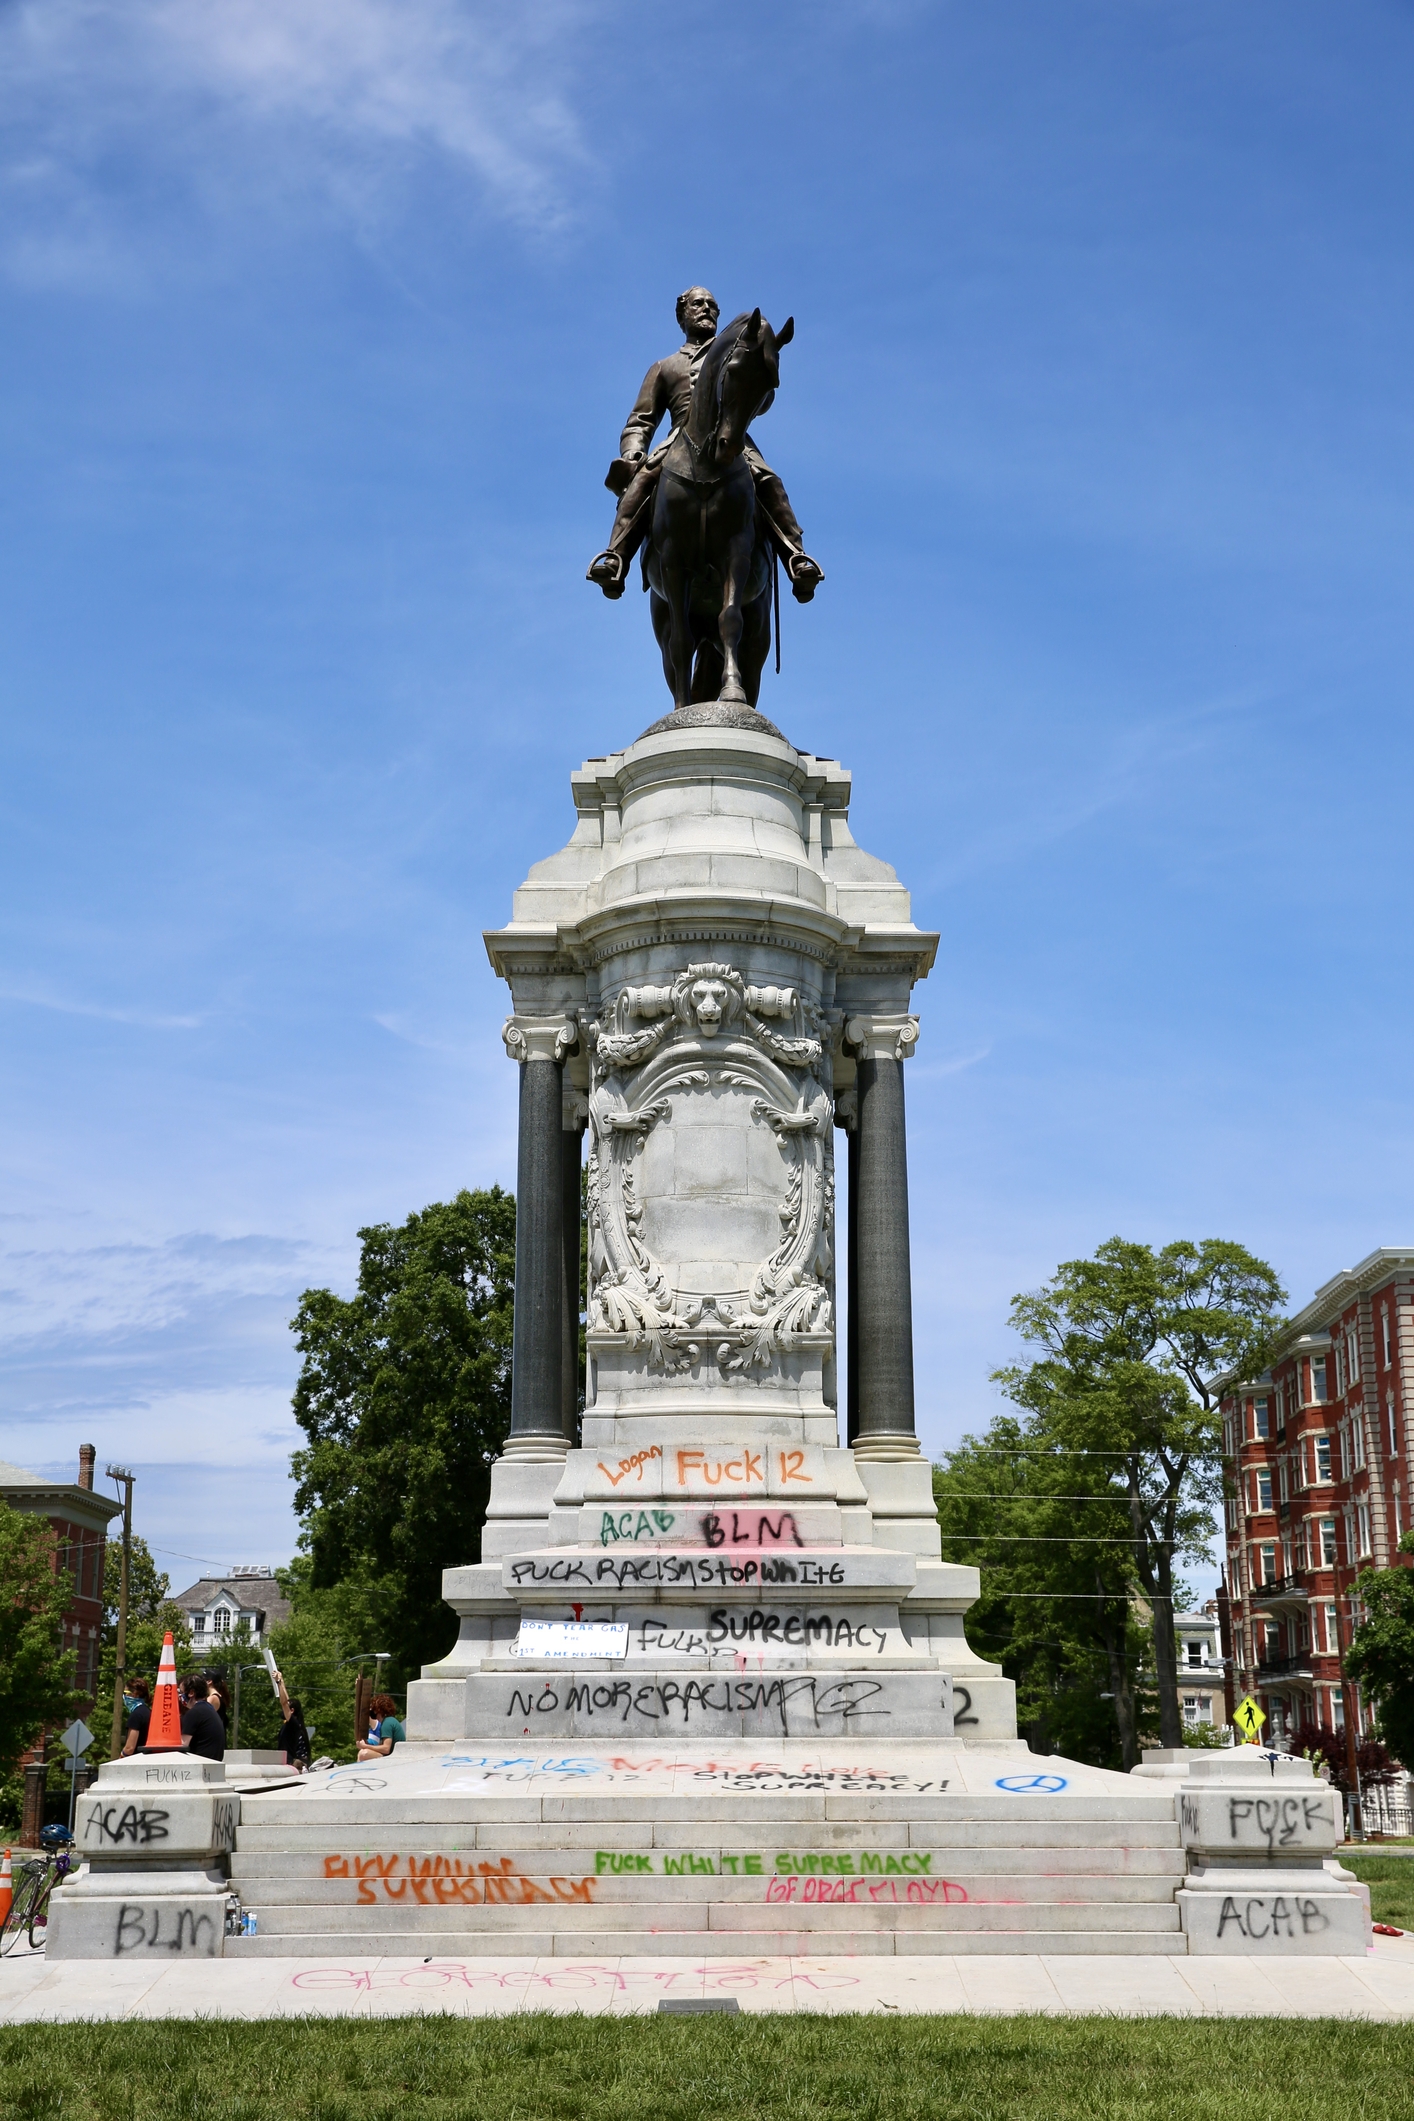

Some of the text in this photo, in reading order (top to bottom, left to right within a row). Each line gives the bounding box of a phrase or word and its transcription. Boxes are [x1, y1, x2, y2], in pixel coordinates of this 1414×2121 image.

[597, 1445, 662, 1486] Logan
[780, 1450, 813, 1484] 12
[700, 1511, 804, 1549] BLM
[511, 1555, 696, 1590] FUCK RACISM
[521, 1621, 626, 1633] DON'T TEAR GAS
[707, 1609, 887, 1653] SUPREMACY
[507, 1689, 559, 1717] NO
[565, 1681, 659, 1721] MORE
[656, 1679, 787, 1732] RACISM
[145, 1769, 178, 1784] FUCK
[84, 1801, 170, 1844] ACAB
[212, 1799, 234, 1847] ACAB
[595, 1851, 932, 1876] FUCK WHITE SUPREMACY
[114, 1903, 215, 1956] BLM
[1217, 1896, 1330, 1938] ACAB
